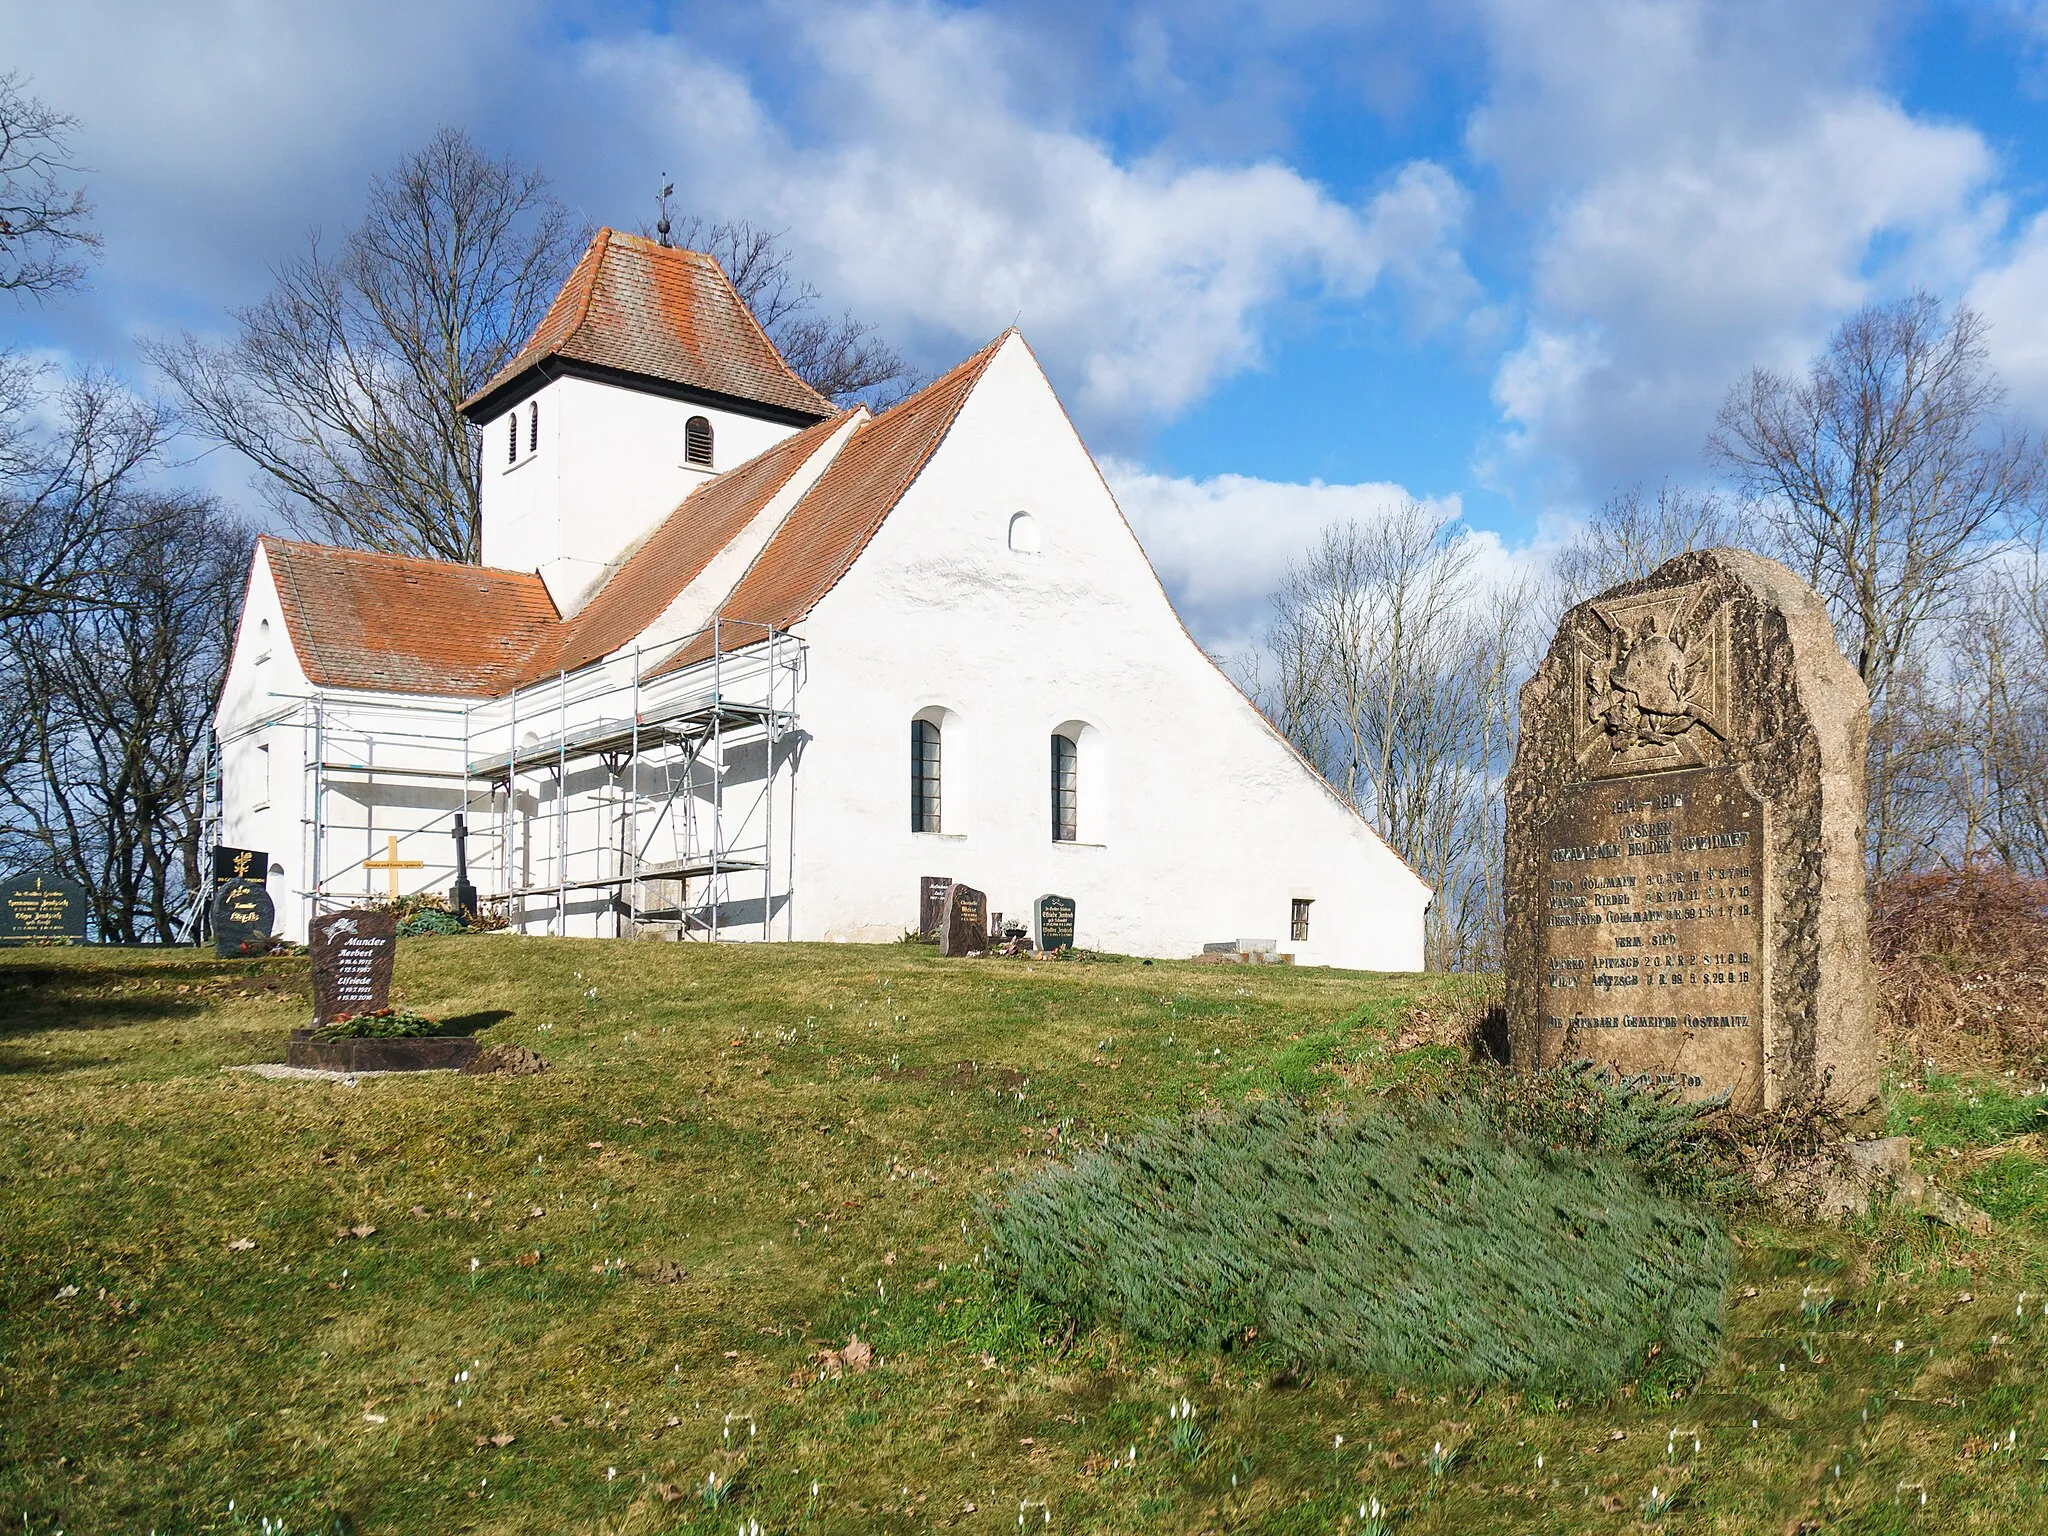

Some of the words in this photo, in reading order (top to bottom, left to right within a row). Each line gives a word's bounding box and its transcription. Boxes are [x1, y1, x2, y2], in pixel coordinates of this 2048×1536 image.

[1610, 798, 1636, 814] 1914
[1656, 793, 1683, 810] 1918
[344, 937, 386, 946] Munder
[338, 949, 374, 957] Herbert
[337, 976, 372, 985] Elfriede
